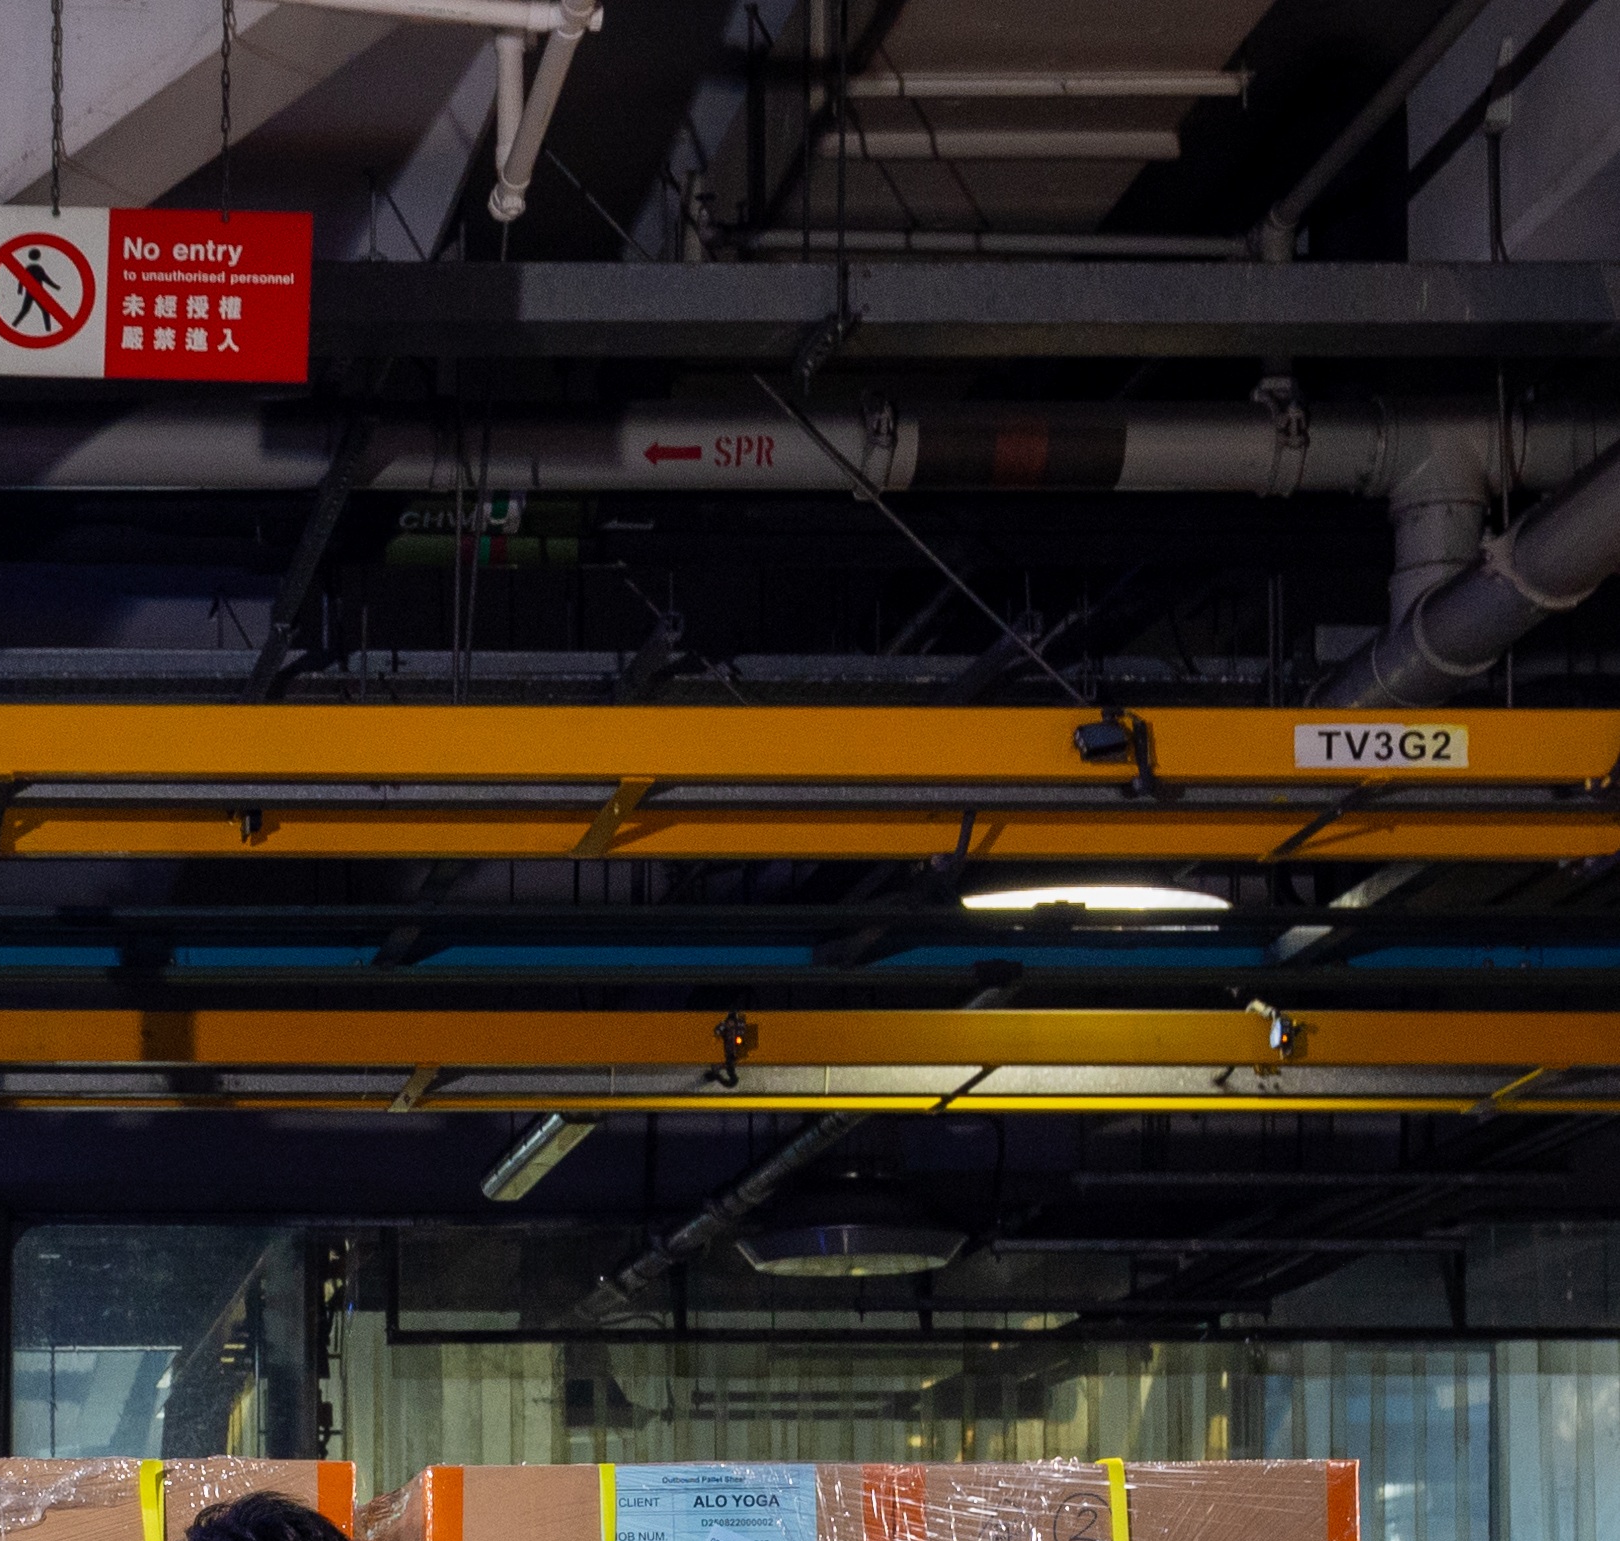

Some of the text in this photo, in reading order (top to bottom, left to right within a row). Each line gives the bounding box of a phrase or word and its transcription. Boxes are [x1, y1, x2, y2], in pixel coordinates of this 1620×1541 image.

[123, 236, 243, 267] No entry
[123, 269, 295, 286] to unauthorised personnel
[122, 293, 243, 321] 未經授權
[121, 325, 241, 354] 嚴禁進入
[713, 434, 776, 468] SPR
[1317, 730, 1452, 761] TV3G2
[618, 1494, 780, 1508] CLIENT ALO YOGA
